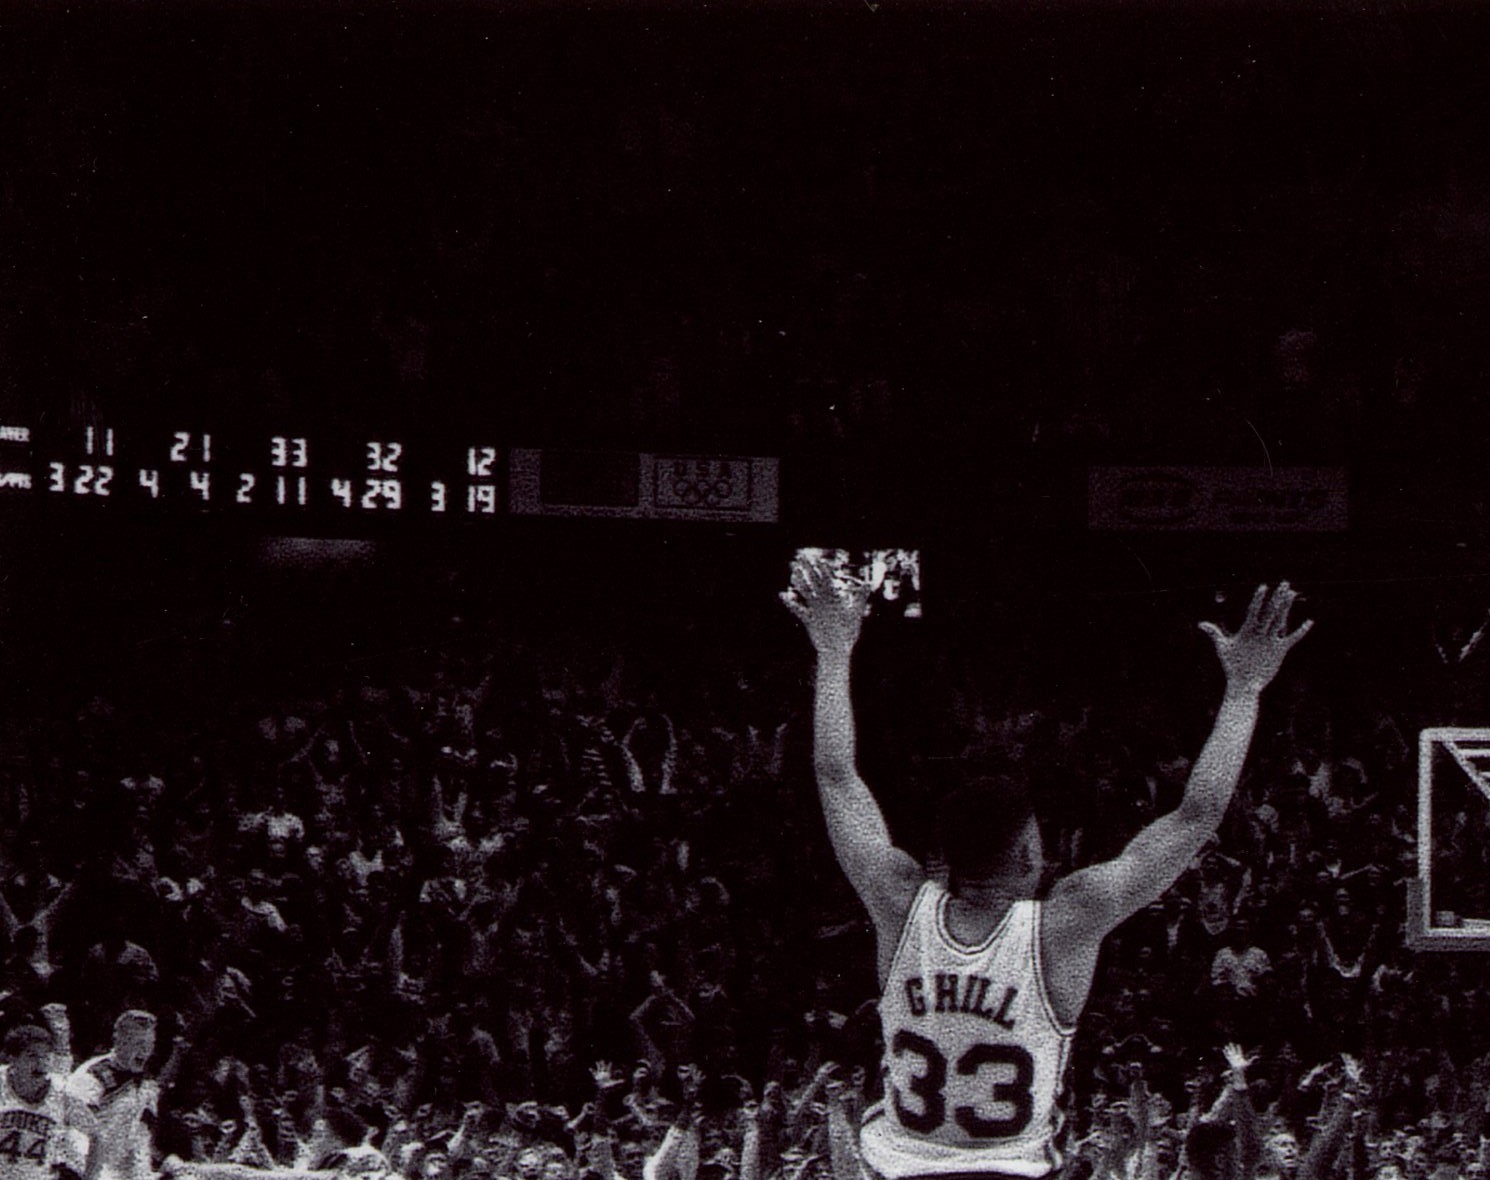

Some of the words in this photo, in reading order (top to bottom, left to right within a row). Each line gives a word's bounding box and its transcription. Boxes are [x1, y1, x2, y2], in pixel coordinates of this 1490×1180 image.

[88, 427, 113, 455] 11
[171, 433, 210, 461] 21
[272, 438, 307, 466] 33
[368, 443, 401, 471] 32
[469, 449, 495, 475] 12
[50, 463, 64, 491] 3
[75, 466, 112, 495] 22
[140, 470, 158, 497] 4
[191, 472, 209, 499] 4
[237, 474, 254, 502] 2
[278, 477, 305, 504] 11
[332, 479, 350, 507] 4
[362, 480, 401, 509] 29
[432, 482, 445, 511] 3
[469, 486, 494, 512] 19
[935, 973, 1018, 1030] HILL
[892, 1028, 1035, 1138] 33
